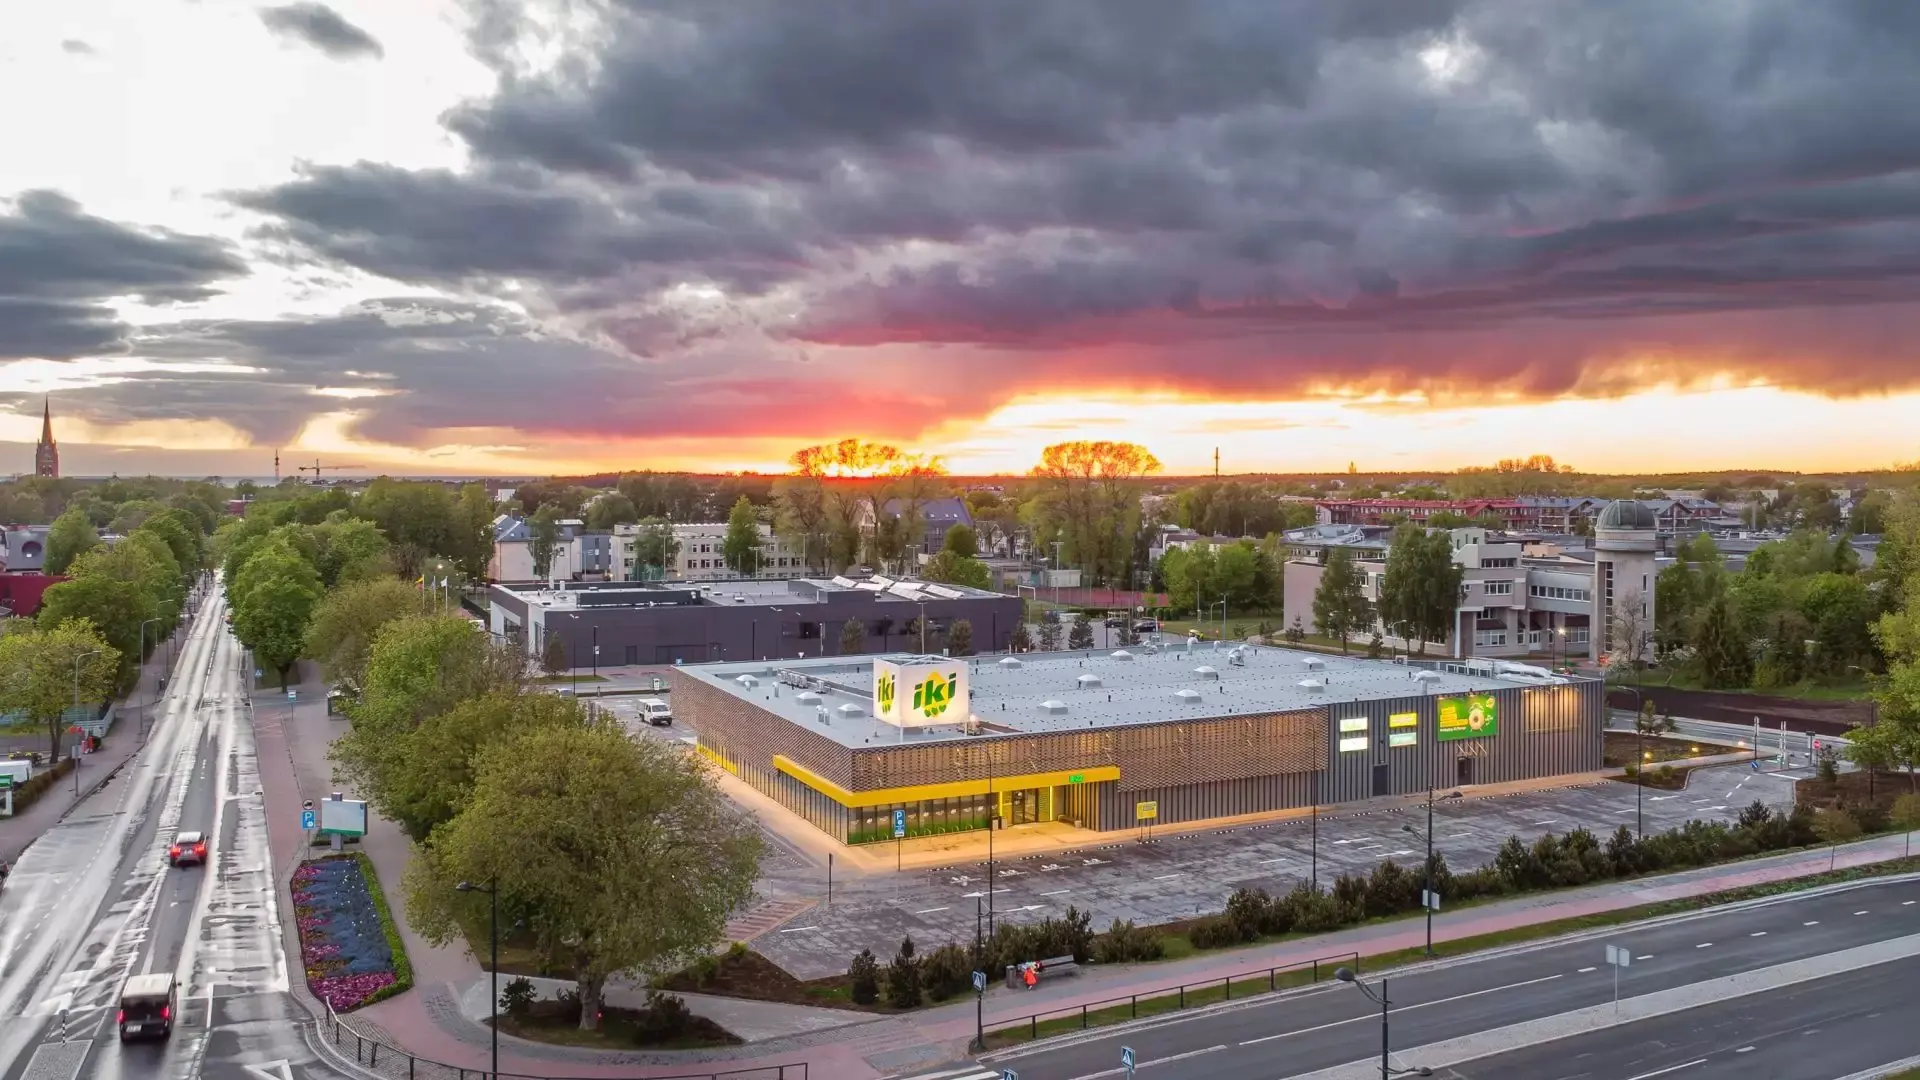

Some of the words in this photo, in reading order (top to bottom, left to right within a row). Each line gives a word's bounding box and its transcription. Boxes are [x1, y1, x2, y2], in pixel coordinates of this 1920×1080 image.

[878, 674, 895, 702] iki
[913, 672, 957, 710] iki
[304, 812, 312, 822] P
[897, 811, 903, 820] P
